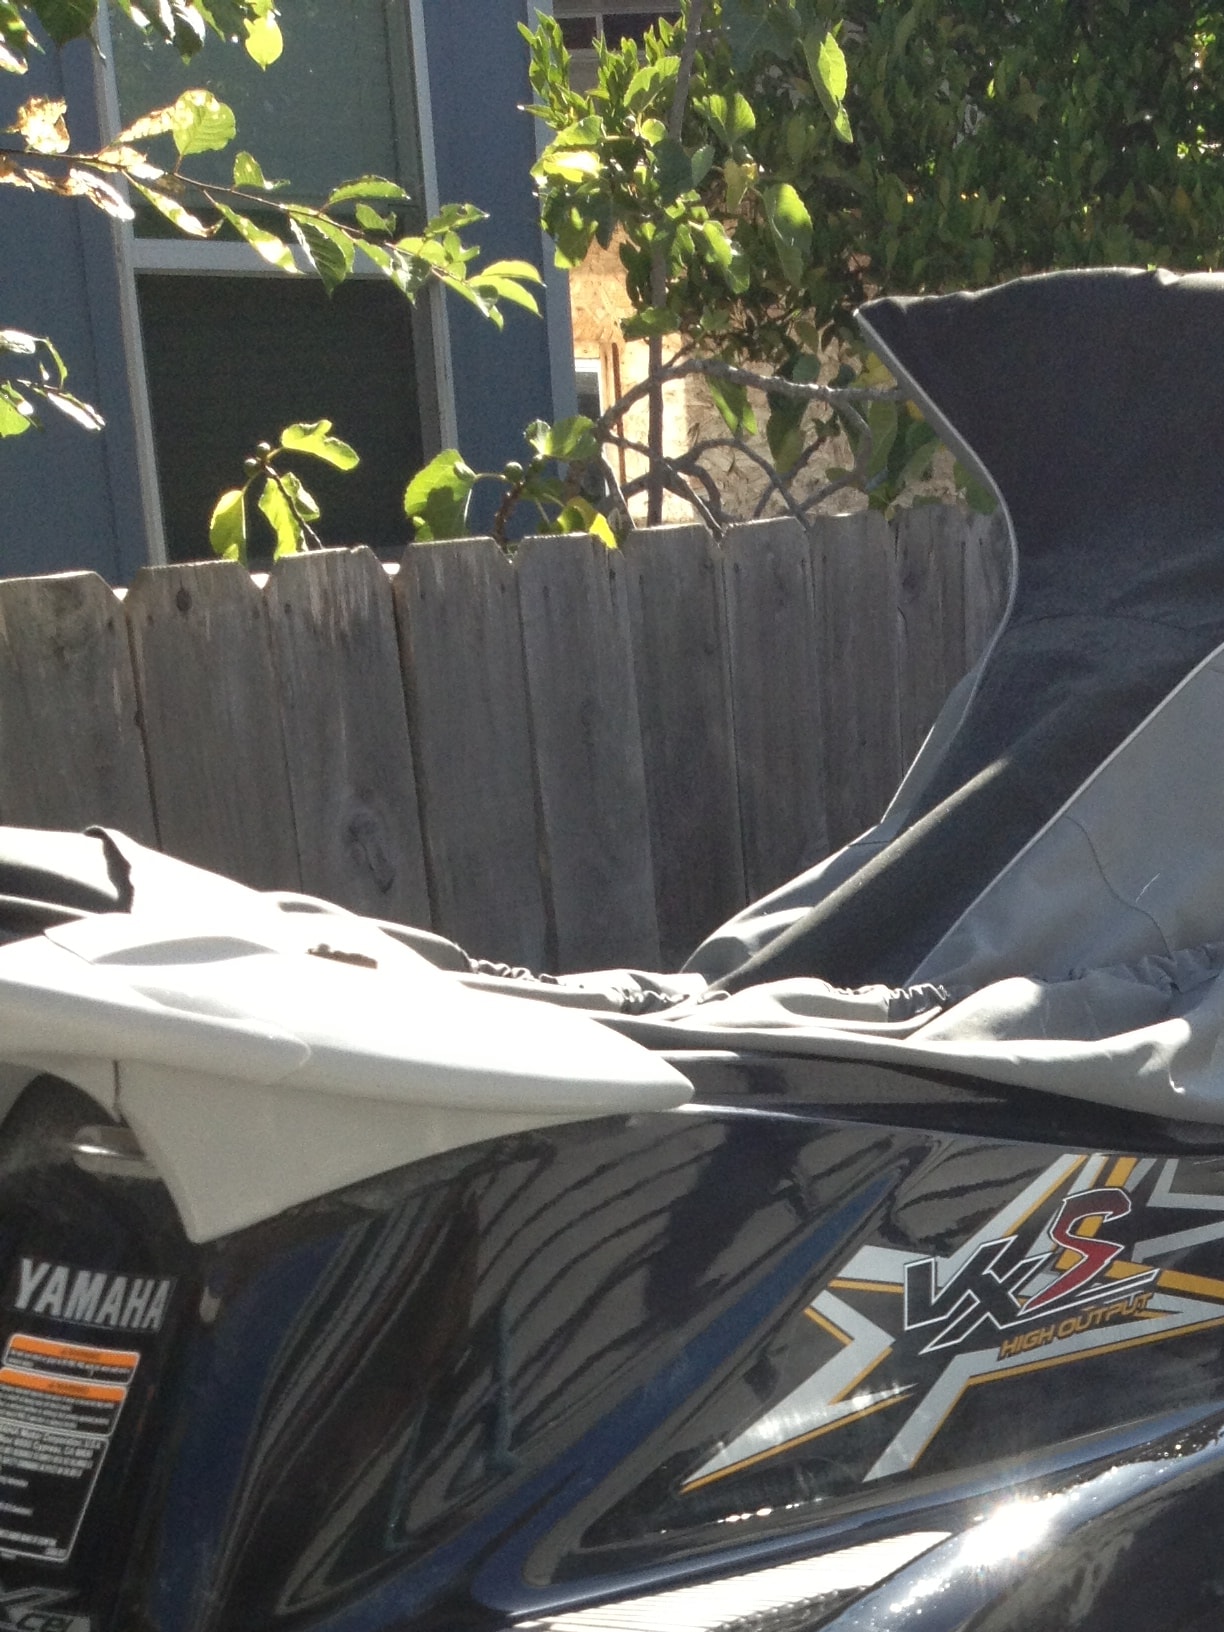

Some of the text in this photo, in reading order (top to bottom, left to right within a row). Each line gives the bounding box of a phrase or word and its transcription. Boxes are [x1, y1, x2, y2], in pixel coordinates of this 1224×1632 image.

[14, 1258, 171, 1329] YAMAHA
[998, 1292, 1153, 1361] HIGH OUTPUT
